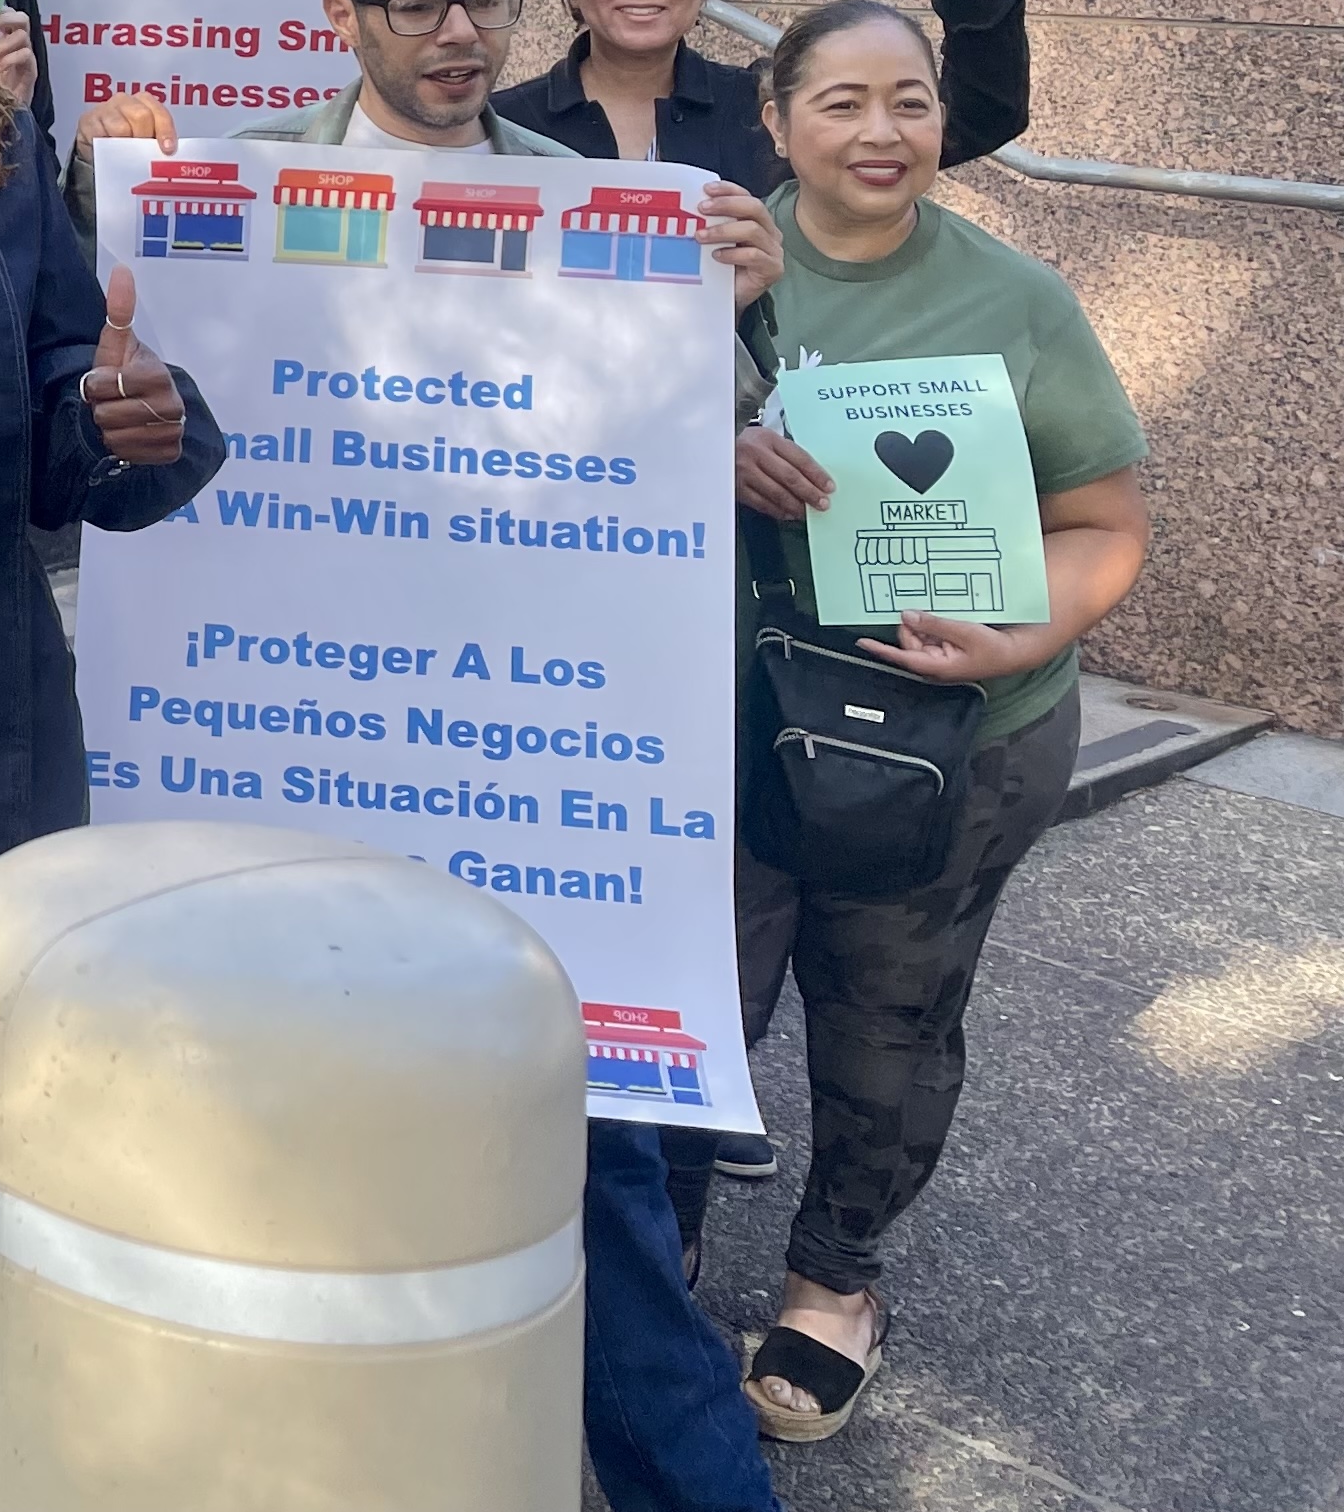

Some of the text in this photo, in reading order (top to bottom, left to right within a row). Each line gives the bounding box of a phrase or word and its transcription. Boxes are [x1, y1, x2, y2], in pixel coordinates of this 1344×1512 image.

[180, 165, 653, 205] SHOP SHOP SHOP SHOP
[272, 358, 533, 411] Protected
[817, 379, 988, 400] SUPPORT SMALL
[845, 402, 973, 420] BUSINESSES
[221, 427, 637, 485] mall Businesses
[216, 489, 429, 540] Win-Win
[449, 507, 706, 560] situation!
[887, 503, 959, 521] MARKET
[187, 623, 606, 690] ¡Proteger A Los
[129, 686, 665, 765] Pequeños Negocios
[86, 751, 716, 841] Es Una Situación En La
[449, 849, 643, 906] Ganan!
